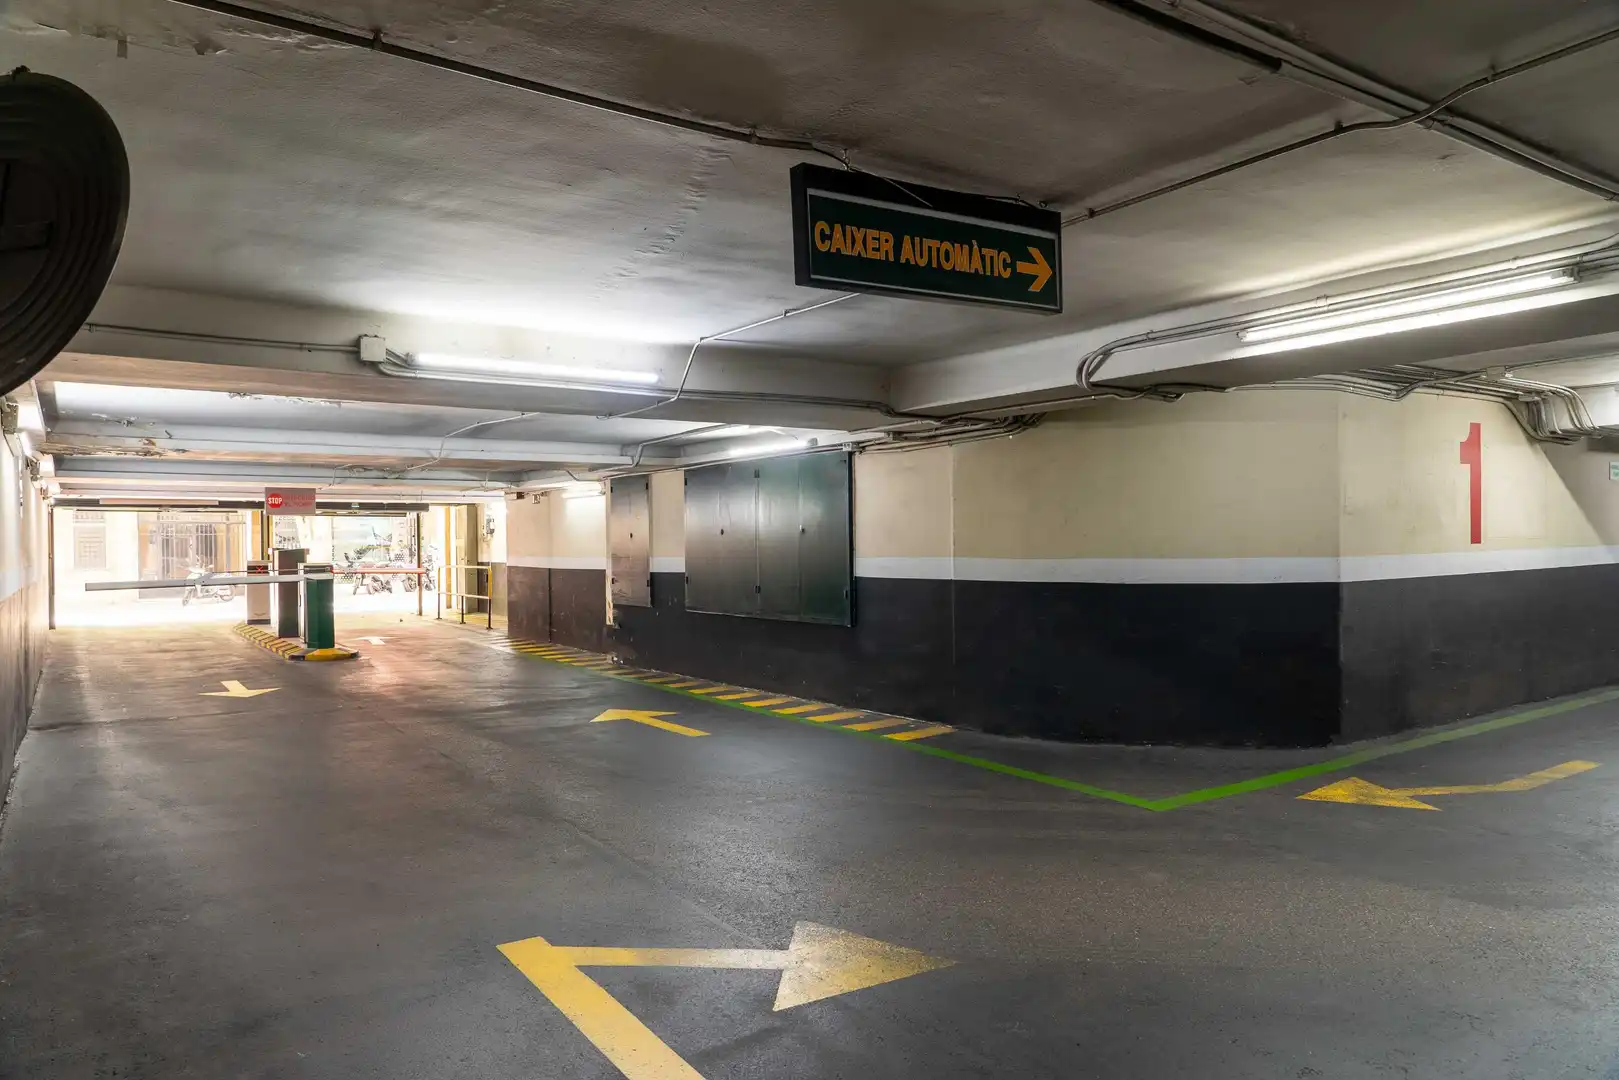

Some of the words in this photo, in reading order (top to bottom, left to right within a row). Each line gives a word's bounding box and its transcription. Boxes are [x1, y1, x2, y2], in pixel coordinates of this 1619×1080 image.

[814, 221, 894, 262] CAIXER
[900, 235, 1012, 279] AUTOMÀTIC
[1460, 422, 1481, 544] 1
